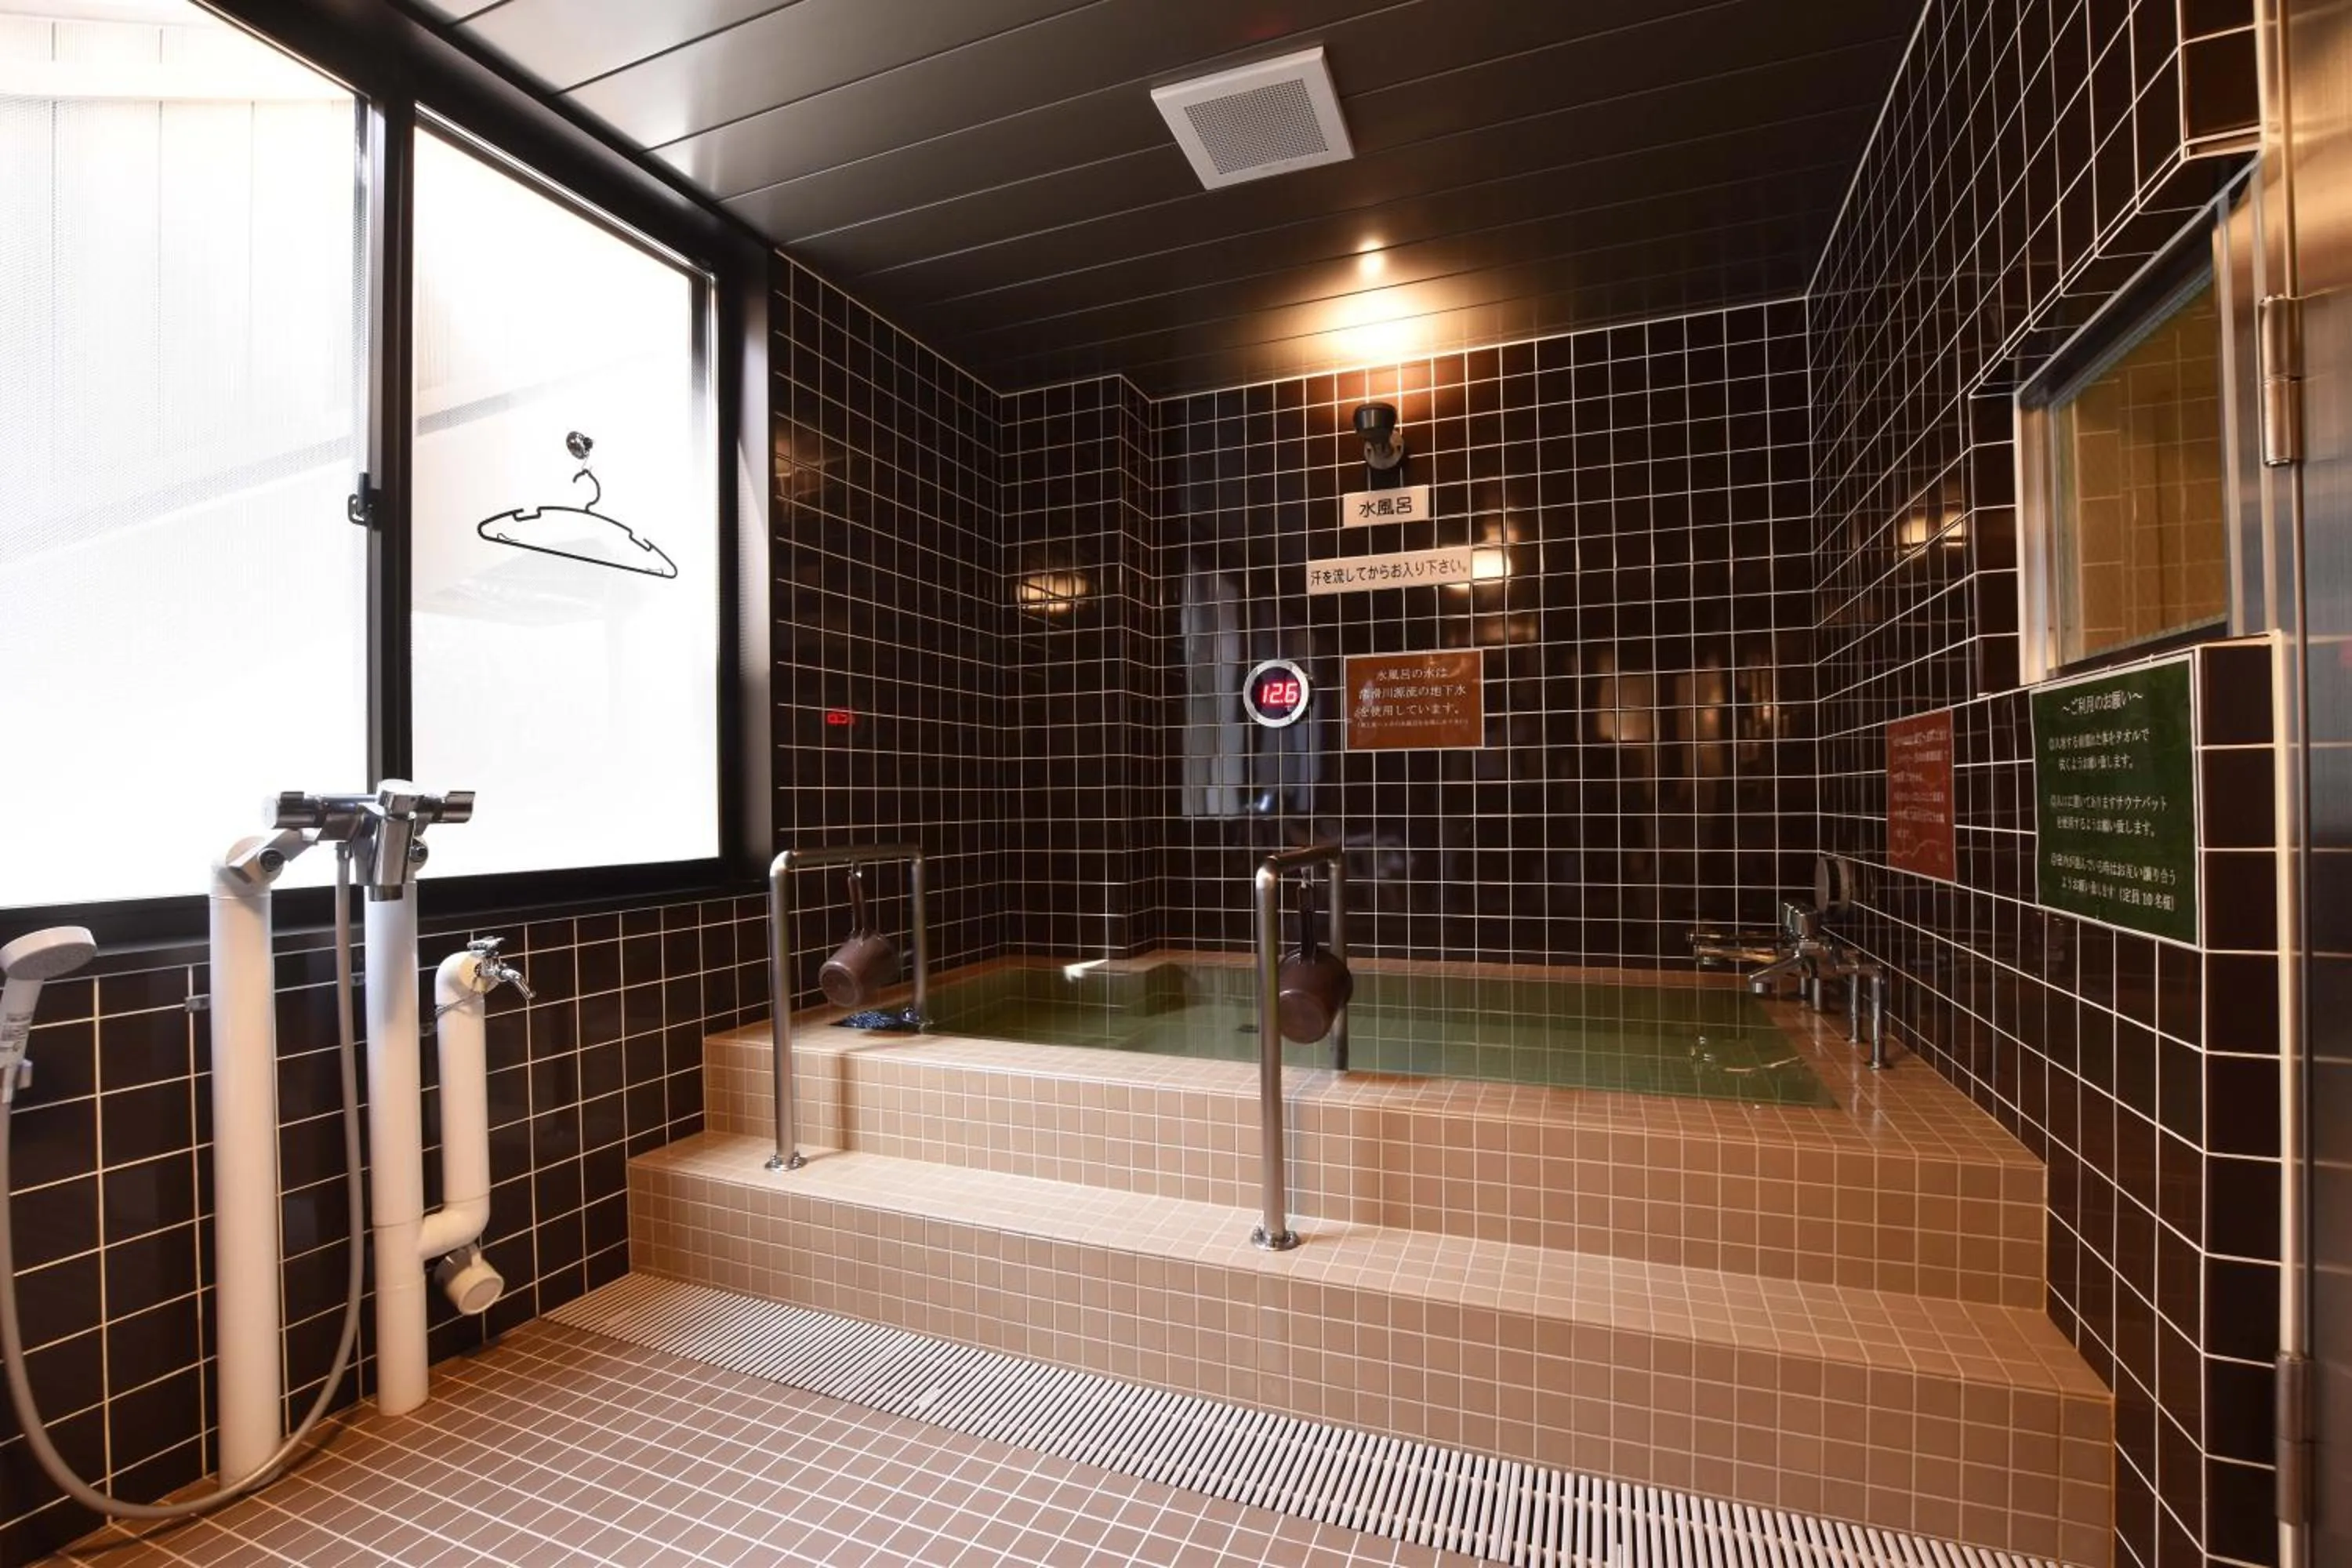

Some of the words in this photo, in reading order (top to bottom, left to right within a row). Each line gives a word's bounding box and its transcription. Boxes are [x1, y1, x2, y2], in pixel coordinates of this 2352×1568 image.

[1359, 496, 1413, 518] 水風呂
[1310, 559, 1467, 586] 汗を流してからお入り下さい。
[1376, 667, 1447, 681] 水風呂の水は
[1262, 682, 1298, 703] 12.6
